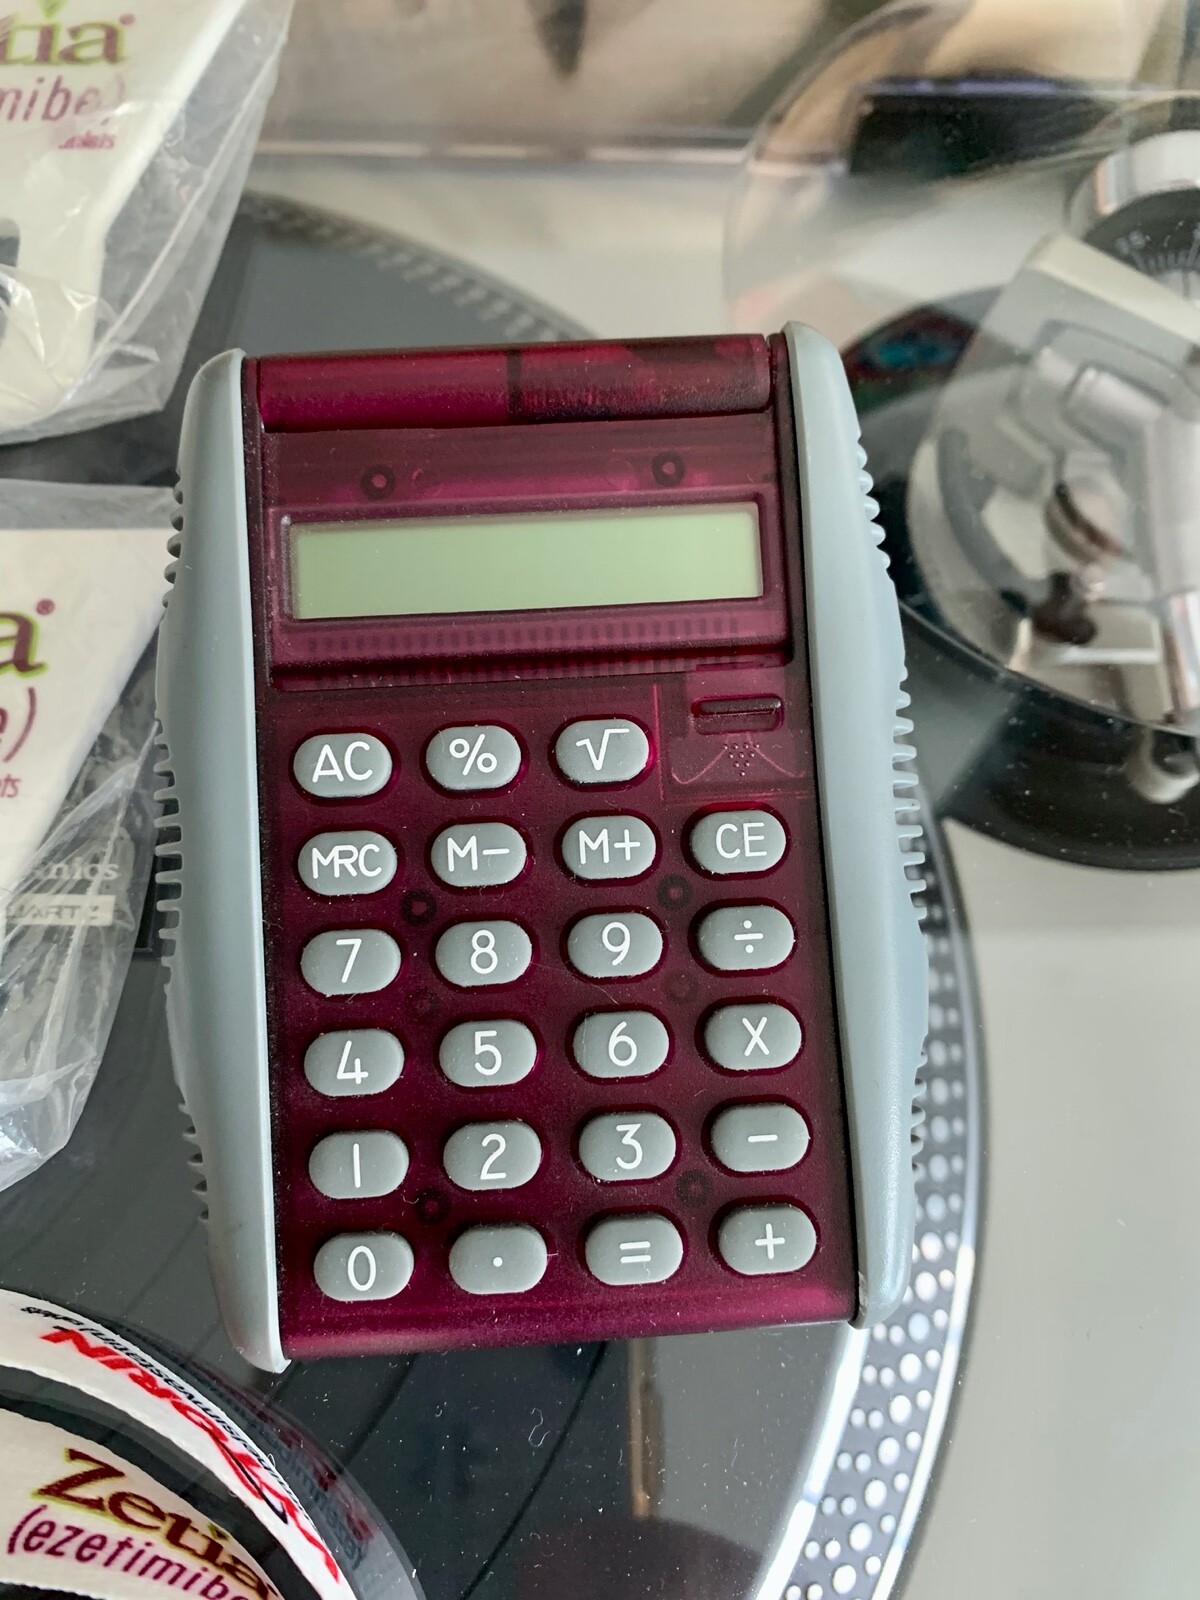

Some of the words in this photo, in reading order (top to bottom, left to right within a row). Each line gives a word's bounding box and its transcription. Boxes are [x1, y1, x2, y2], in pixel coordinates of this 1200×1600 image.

[312, 741, 373, 783] AC
[449, 733, 498, 776] %
[312, 843, 382, 879] MRC
[447, 835, 510, 872] M-
[579, 828, 641, 865] M+
[716, 822, 768, 859] CE
[336, 938, 362, 984] 7
[470, 929, 498, 975] 8
[602, 921, 631, 966] 9
[336, 1040, 369, 1085] 4
[474, 1030, 502, 1076] 5
[608, 1021, 638, 1067] 6
[480, 1133, 507, 1180] 2
[615, 1123, 643, 1169] 3
[754, 1223, 786, 1260] +
[347, 1245, 377, 1292] 0
